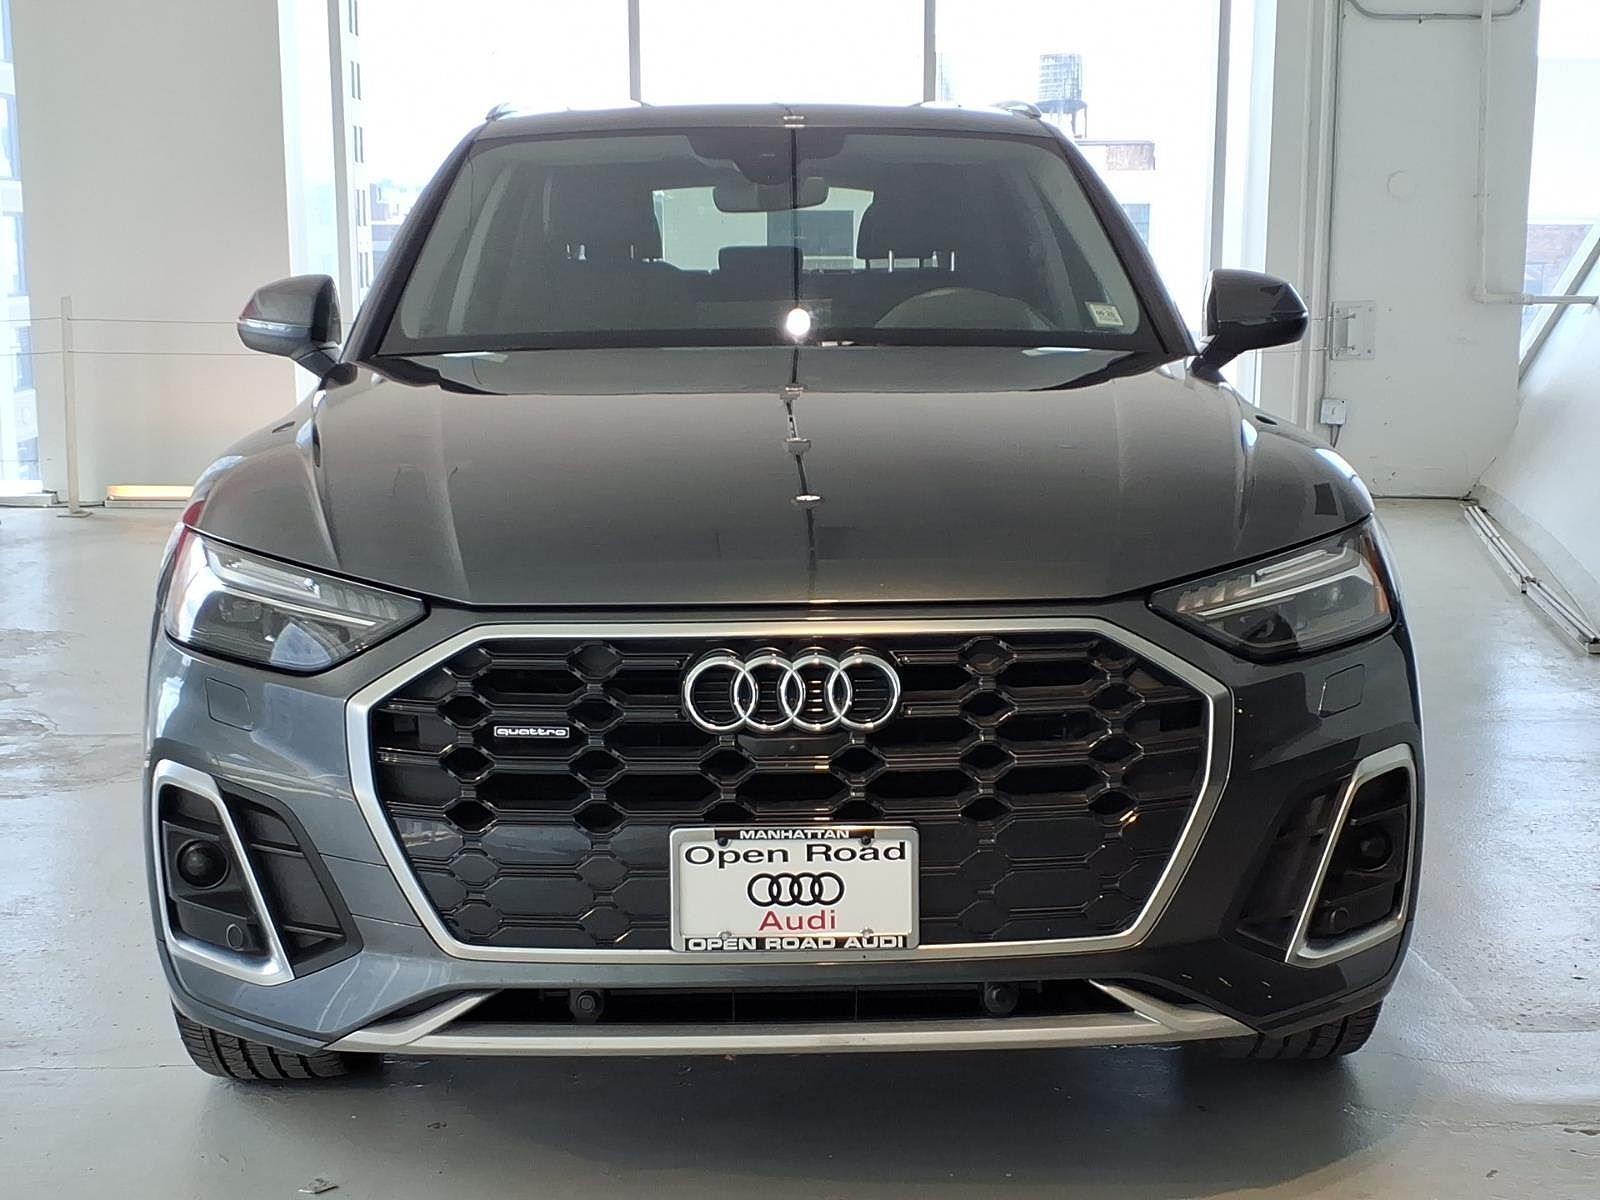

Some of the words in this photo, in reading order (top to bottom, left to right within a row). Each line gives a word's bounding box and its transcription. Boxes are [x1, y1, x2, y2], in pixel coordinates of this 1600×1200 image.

[497, 727, 567, 737] quattro
[739, 829, 850, 840] MANHATTAN
[684, 845, 789, 870] Open
[806, 841, 906, 863] Road
[758, 909, 836, 932] Audi
[688, 936, 757, 951] OPEN
[765, 935, 836, 950] ROAD
[844, 934, 904, 949] AUDI
